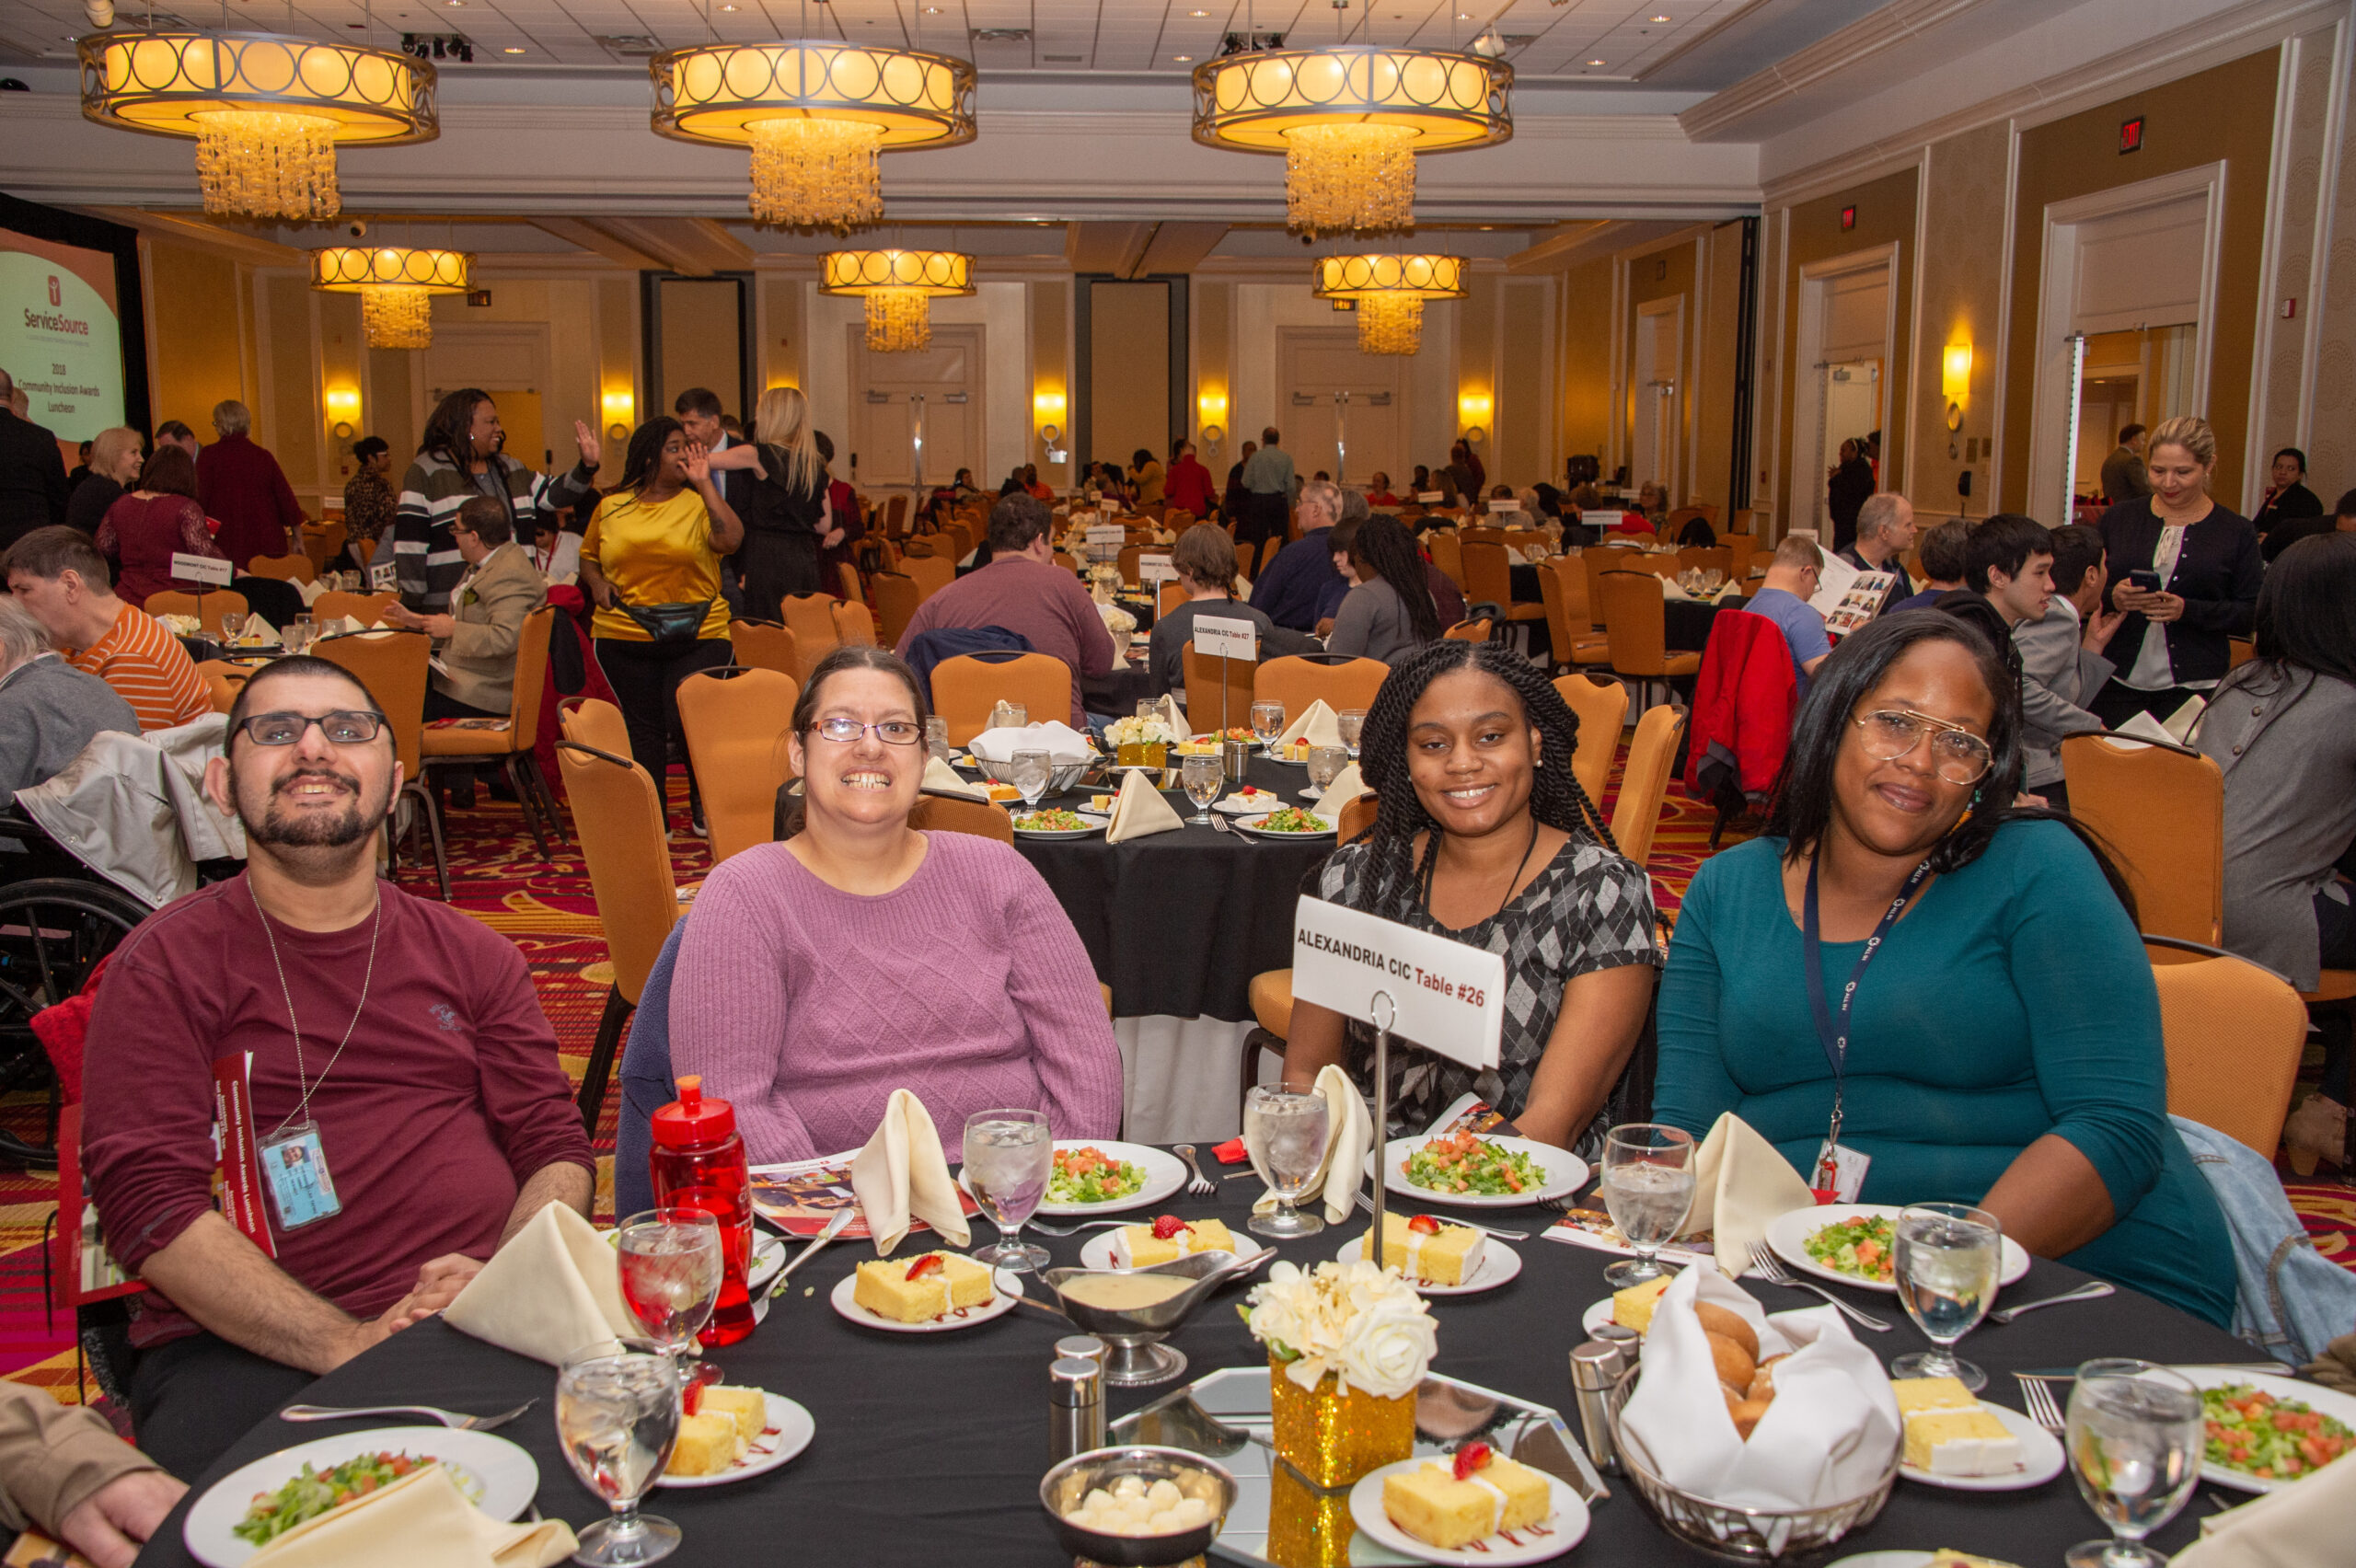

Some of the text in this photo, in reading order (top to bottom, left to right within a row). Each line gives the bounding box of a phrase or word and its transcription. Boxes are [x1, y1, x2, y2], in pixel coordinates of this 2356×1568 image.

[2122, 121, 2141, 148] EXIT
[24, 307, 89, 336] ServiceSource
[52, 363, 67, 375] 2018
[18, 378, 100, 397] Community Inclusion Awards
[47, 401, 75, 413] Luncheon
[1195, 627, 1220, 636] ALEXANDRIA
[1229, 630, 1241, 639] Table
[1297, 928, 1485, 1008] ALEXANDRIA CIC Table #26
[232, 1079, 256, 1233] Community Inclusion Awards Luncheon
